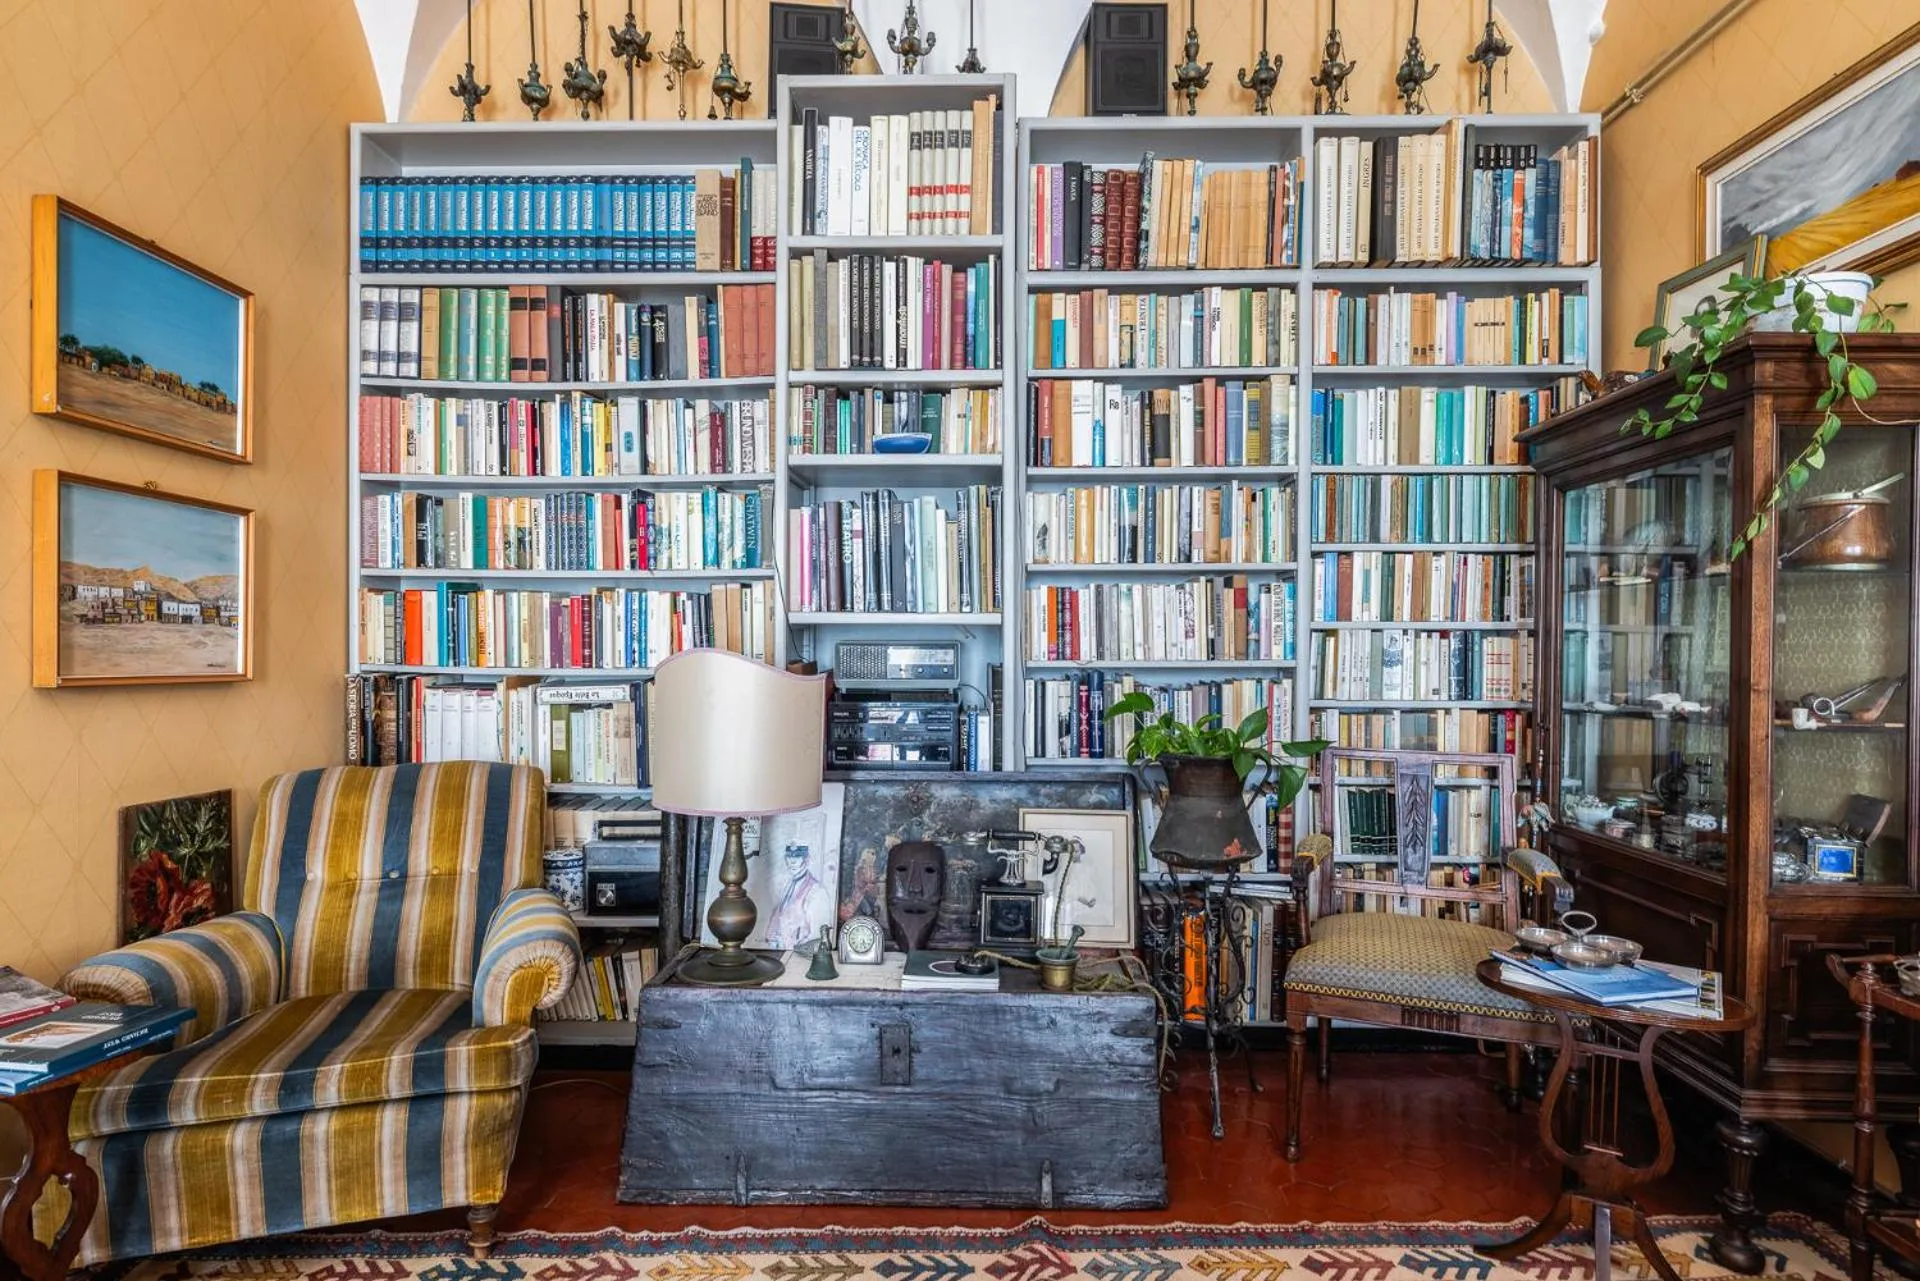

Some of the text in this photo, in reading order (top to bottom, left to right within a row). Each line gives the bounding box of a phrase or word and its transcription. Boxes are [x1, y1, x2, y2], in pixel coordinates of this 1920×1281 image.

[862, 130, 870, 170] CRONACA
[854, 161, 862, 191] SECOLO
[1362, 157, 1371, 188] INGRES
[741, 401, 753, 473] BRUNO VESPA
[746, 496, 756, 549] CHATWIN
[843, 520, 852, 563] TEATRO
[348, 677, 357, 688] LA
[348, 689, 357, 718] STORIA
